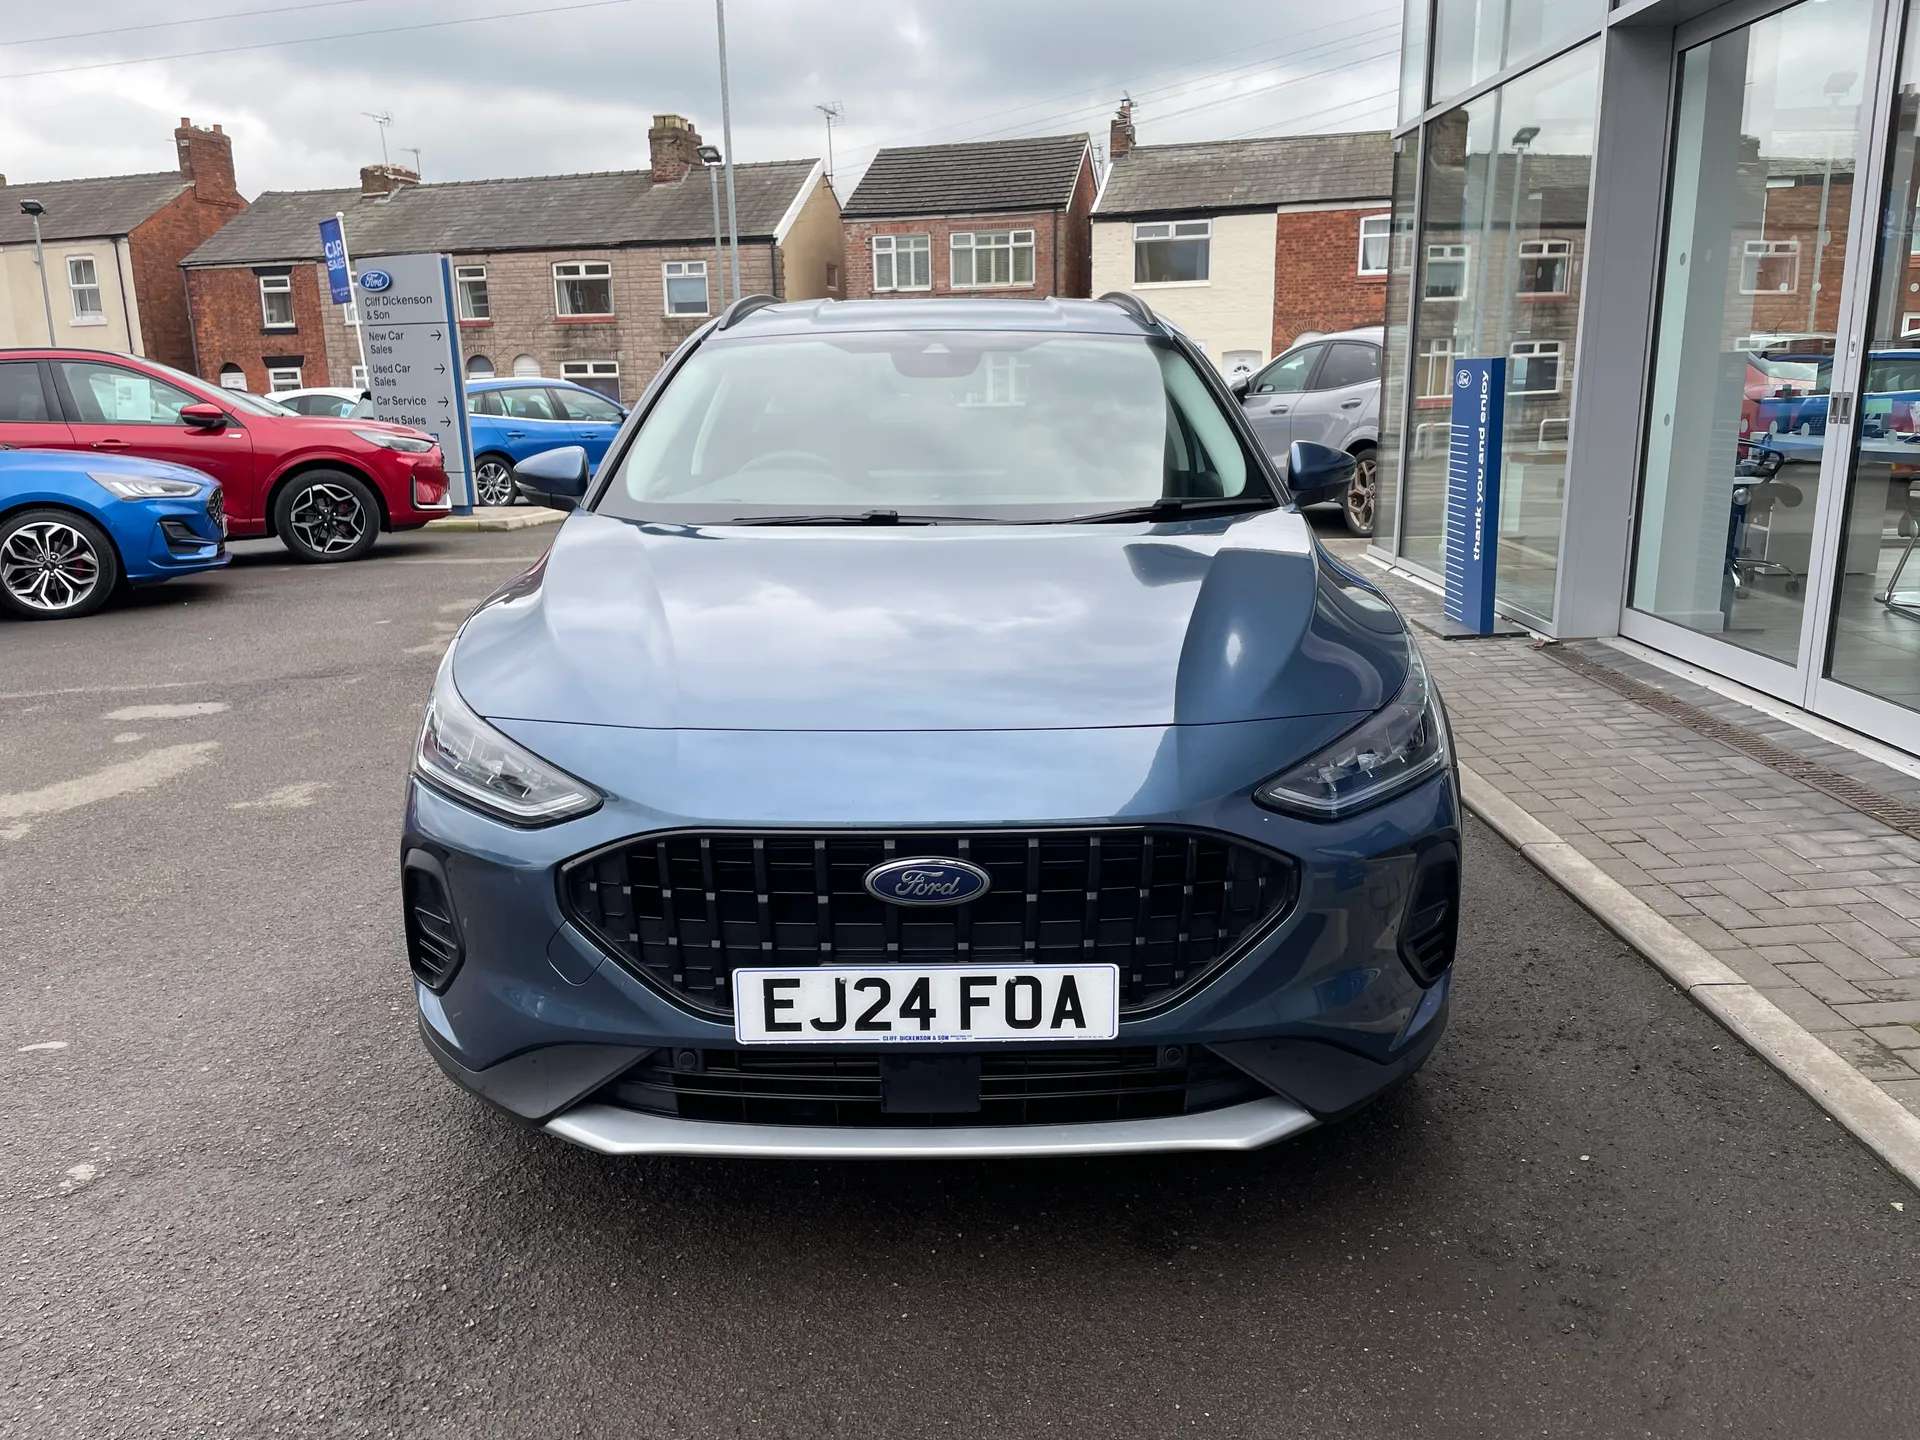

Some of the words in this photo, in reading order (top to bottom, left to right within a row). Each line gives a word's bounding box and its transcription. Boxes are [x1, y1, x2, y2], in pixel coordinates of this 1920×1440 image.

[325, 240, 343, 258] CAR
[364, 273, 384, 288] Ford
[364, 296, 380, 307] Cliff
[382, 295, 433, 306] Dickenson
[366, 311, 372, 320] &
[374, 310, 390, 320] Son
[368, 332, 387, 341] New
[388, 330, 404, 340] Car
[370, 344, 393, 354] Sales
[372, 364, 393, 374] Used
[394, 363, 411, 373] Car
[374, 376, 397, 386] Sales
[376, 395, 391, 406] Car
[392, 395, 427, 406] Service
[1480, 370, 1489, 424] enjoy
[401, 415, 427, 425] Sales
[1478, 427, 1486, 465] and
[1476, 468, 1484, 503] you
[1473, 506, 1482, 561] thank
[895, 869, 961, 896] Ford
[763, 977, 937, 1032] EJ24
[959, 975, 1087, 1030] FOA
